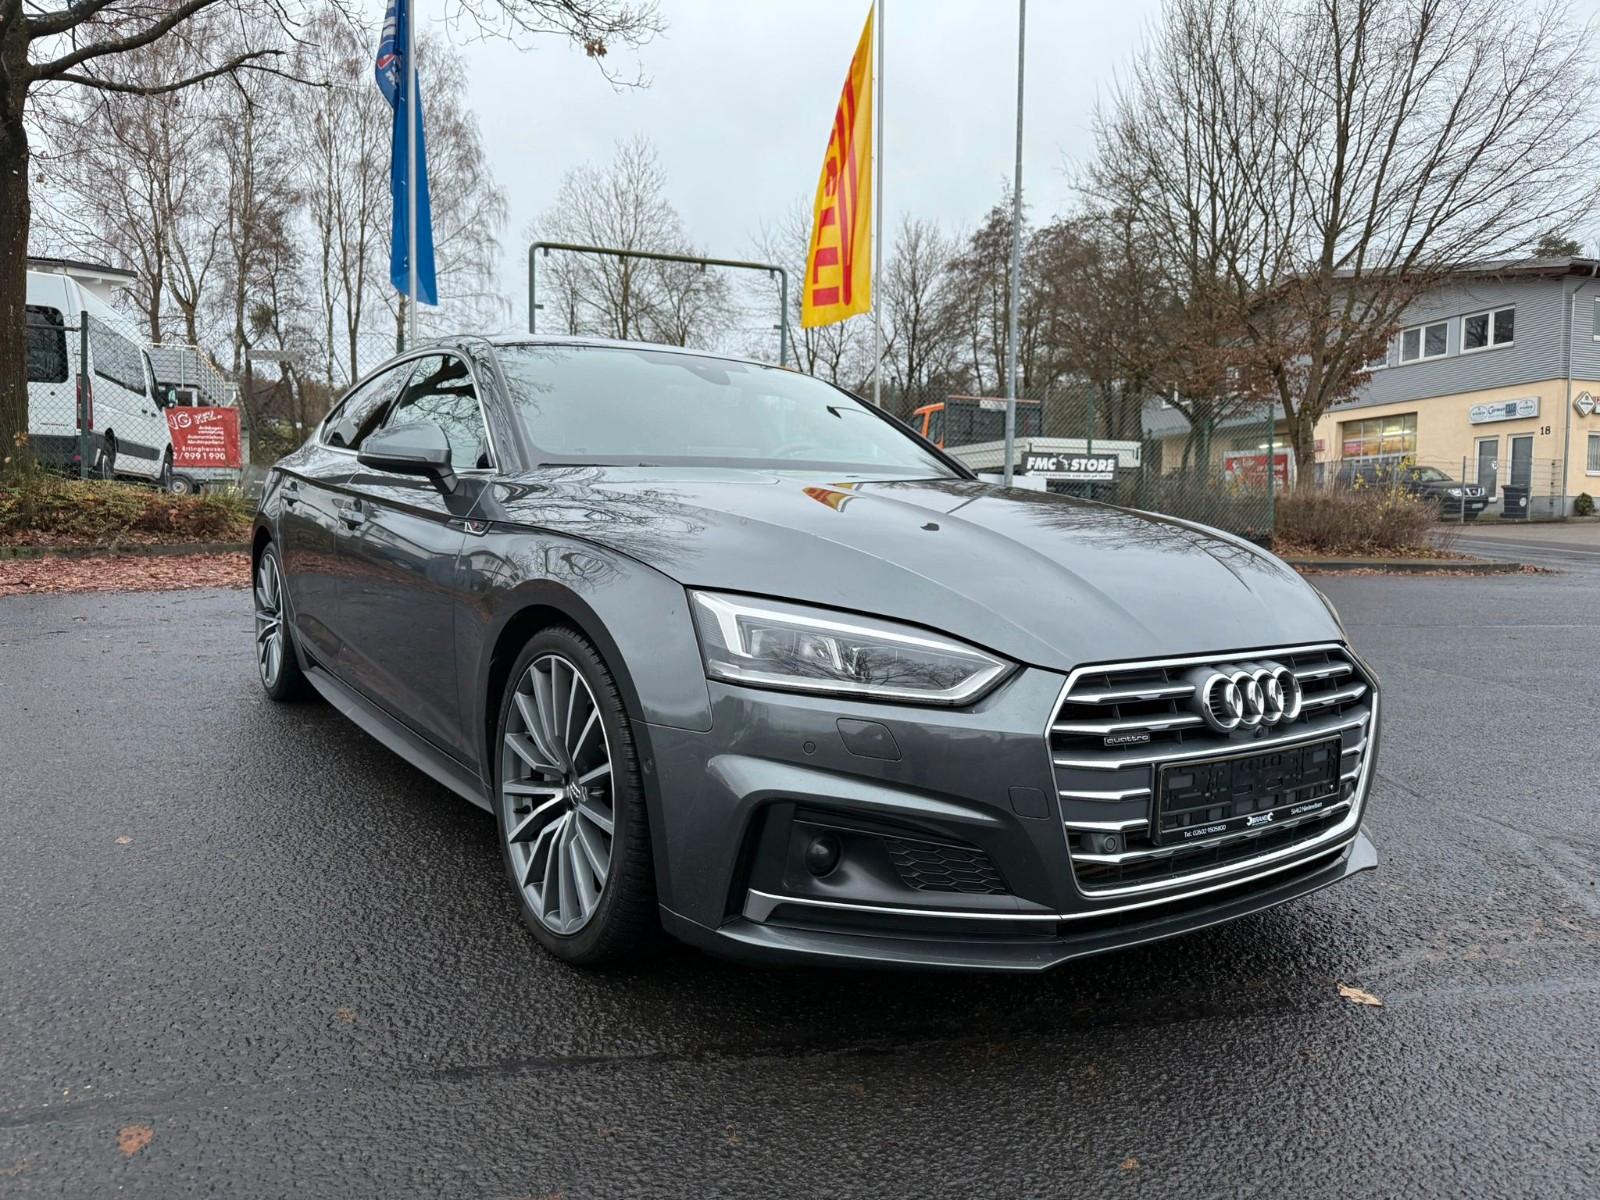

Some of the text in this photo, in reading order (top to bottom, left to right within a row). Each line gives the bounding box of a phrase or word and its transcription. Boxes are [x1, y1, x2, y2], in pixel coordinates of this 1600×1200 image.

[1540, 426, 1551, 435] 18
[1026, 456, 1115, 471] FMC STORE
[1106, 735, 1149, 744] quattro
